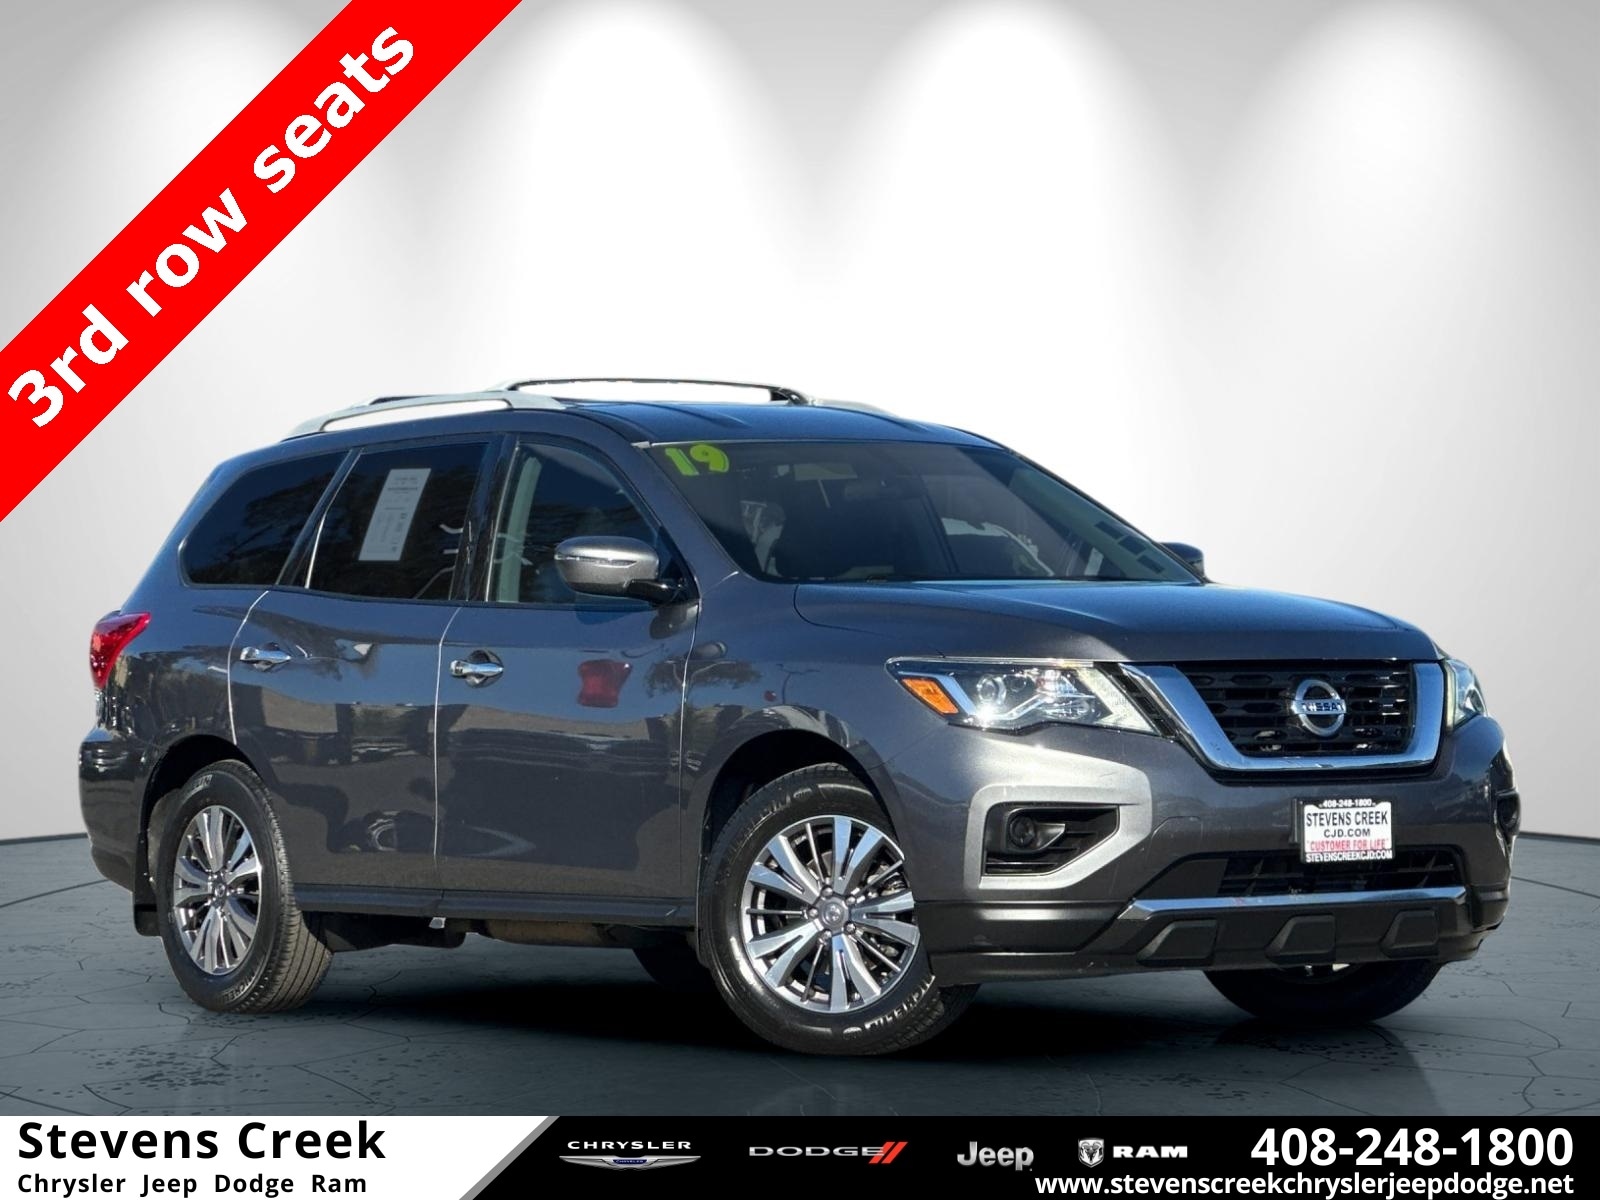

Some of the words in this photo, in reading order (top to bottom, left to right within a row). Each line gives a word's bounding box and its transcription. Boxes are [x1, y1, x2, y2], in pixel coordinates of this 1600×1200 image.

[665, 444, 729, 476] 19
[1306, 812, 1352, 827] STEVENS
[1354, 811, 1388, 825] CREEK
[1323, 828, 1371, 838] CJD.COM
